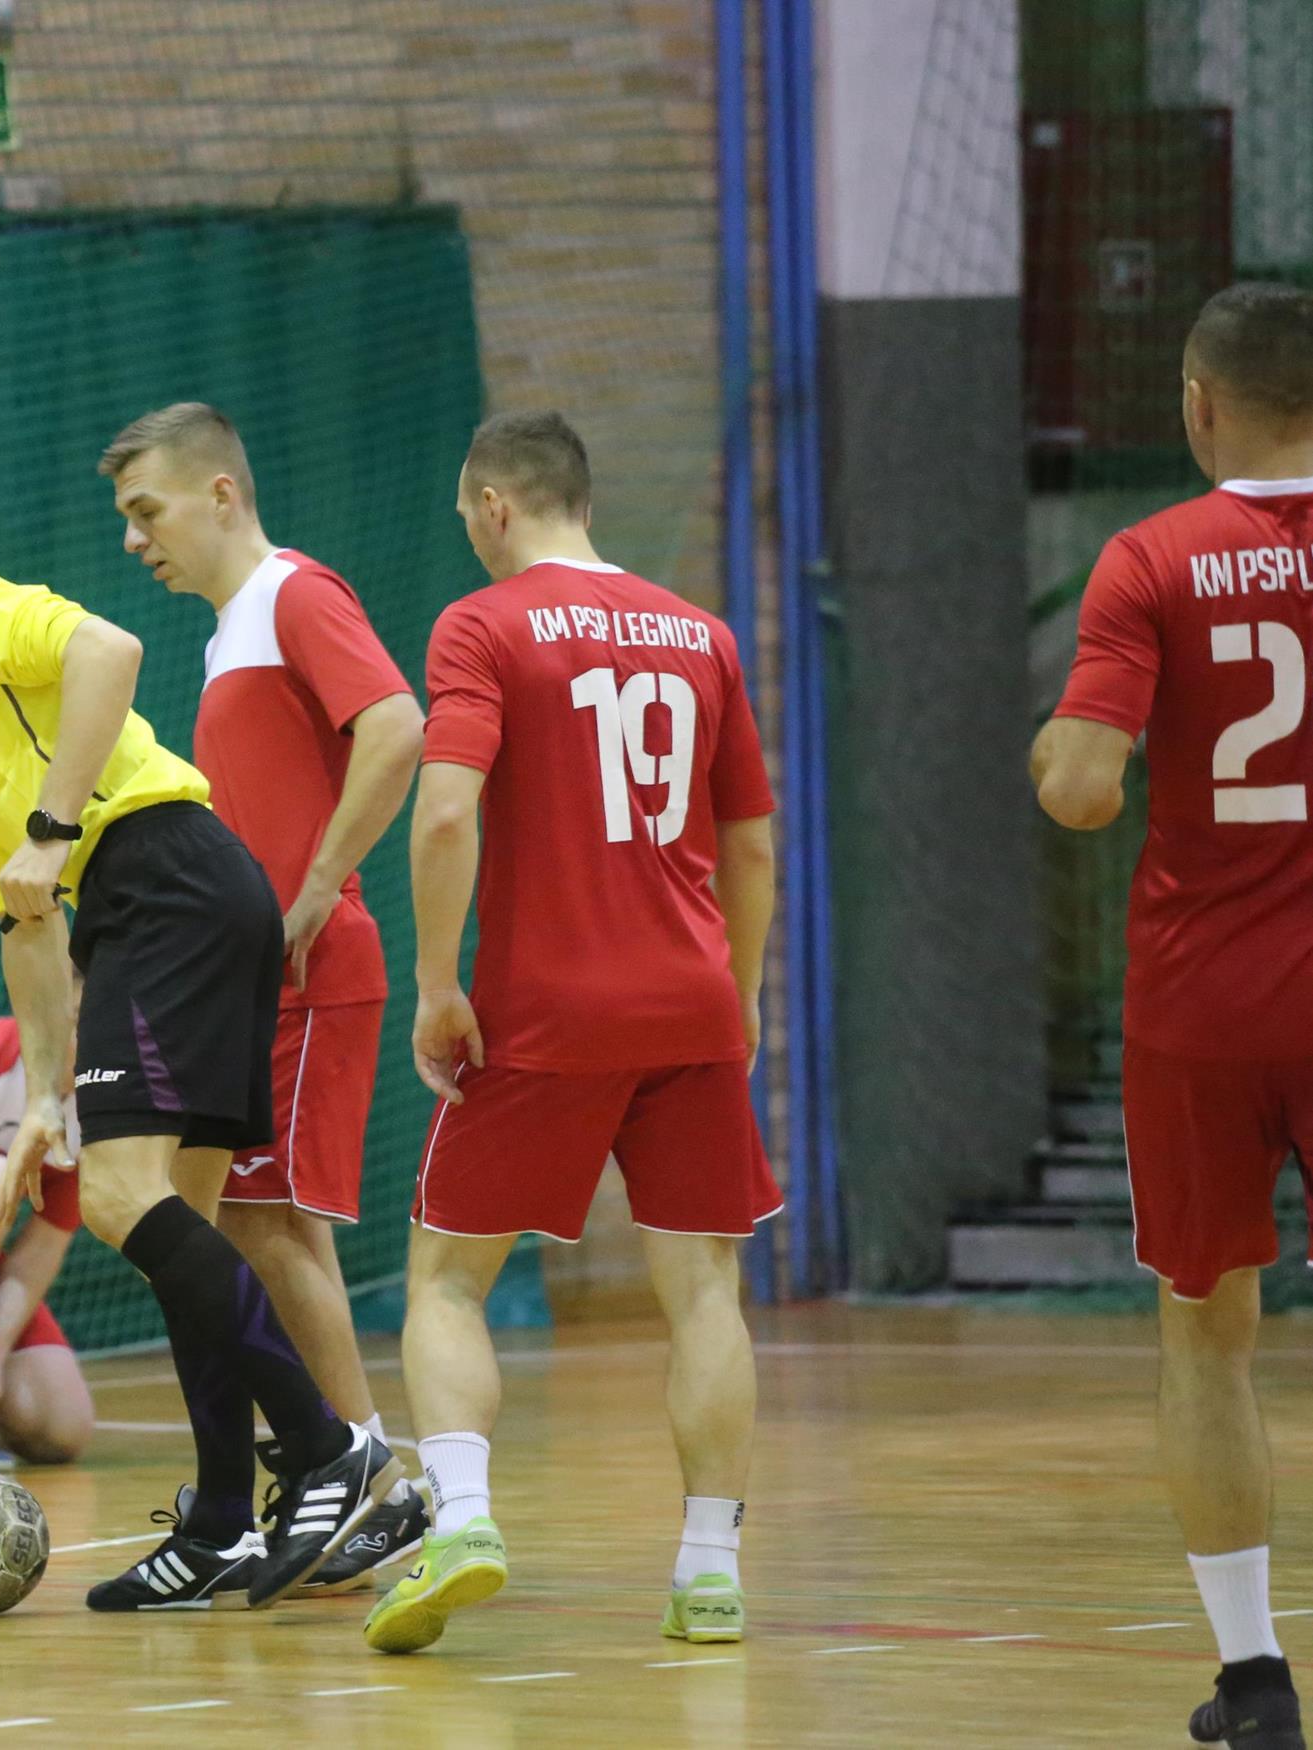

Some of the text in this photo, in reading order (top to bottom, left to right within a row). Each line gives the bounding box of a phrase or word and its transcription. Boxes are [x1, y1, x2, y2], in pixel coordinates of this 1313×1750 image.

[1190, 543, 1313, 599] KM PSP L
[527, 605, 712, 656] KM PSP LEGNICA
[569, 667, 697, 847] 19
[12, 1489, 33, 1566] SELECT
